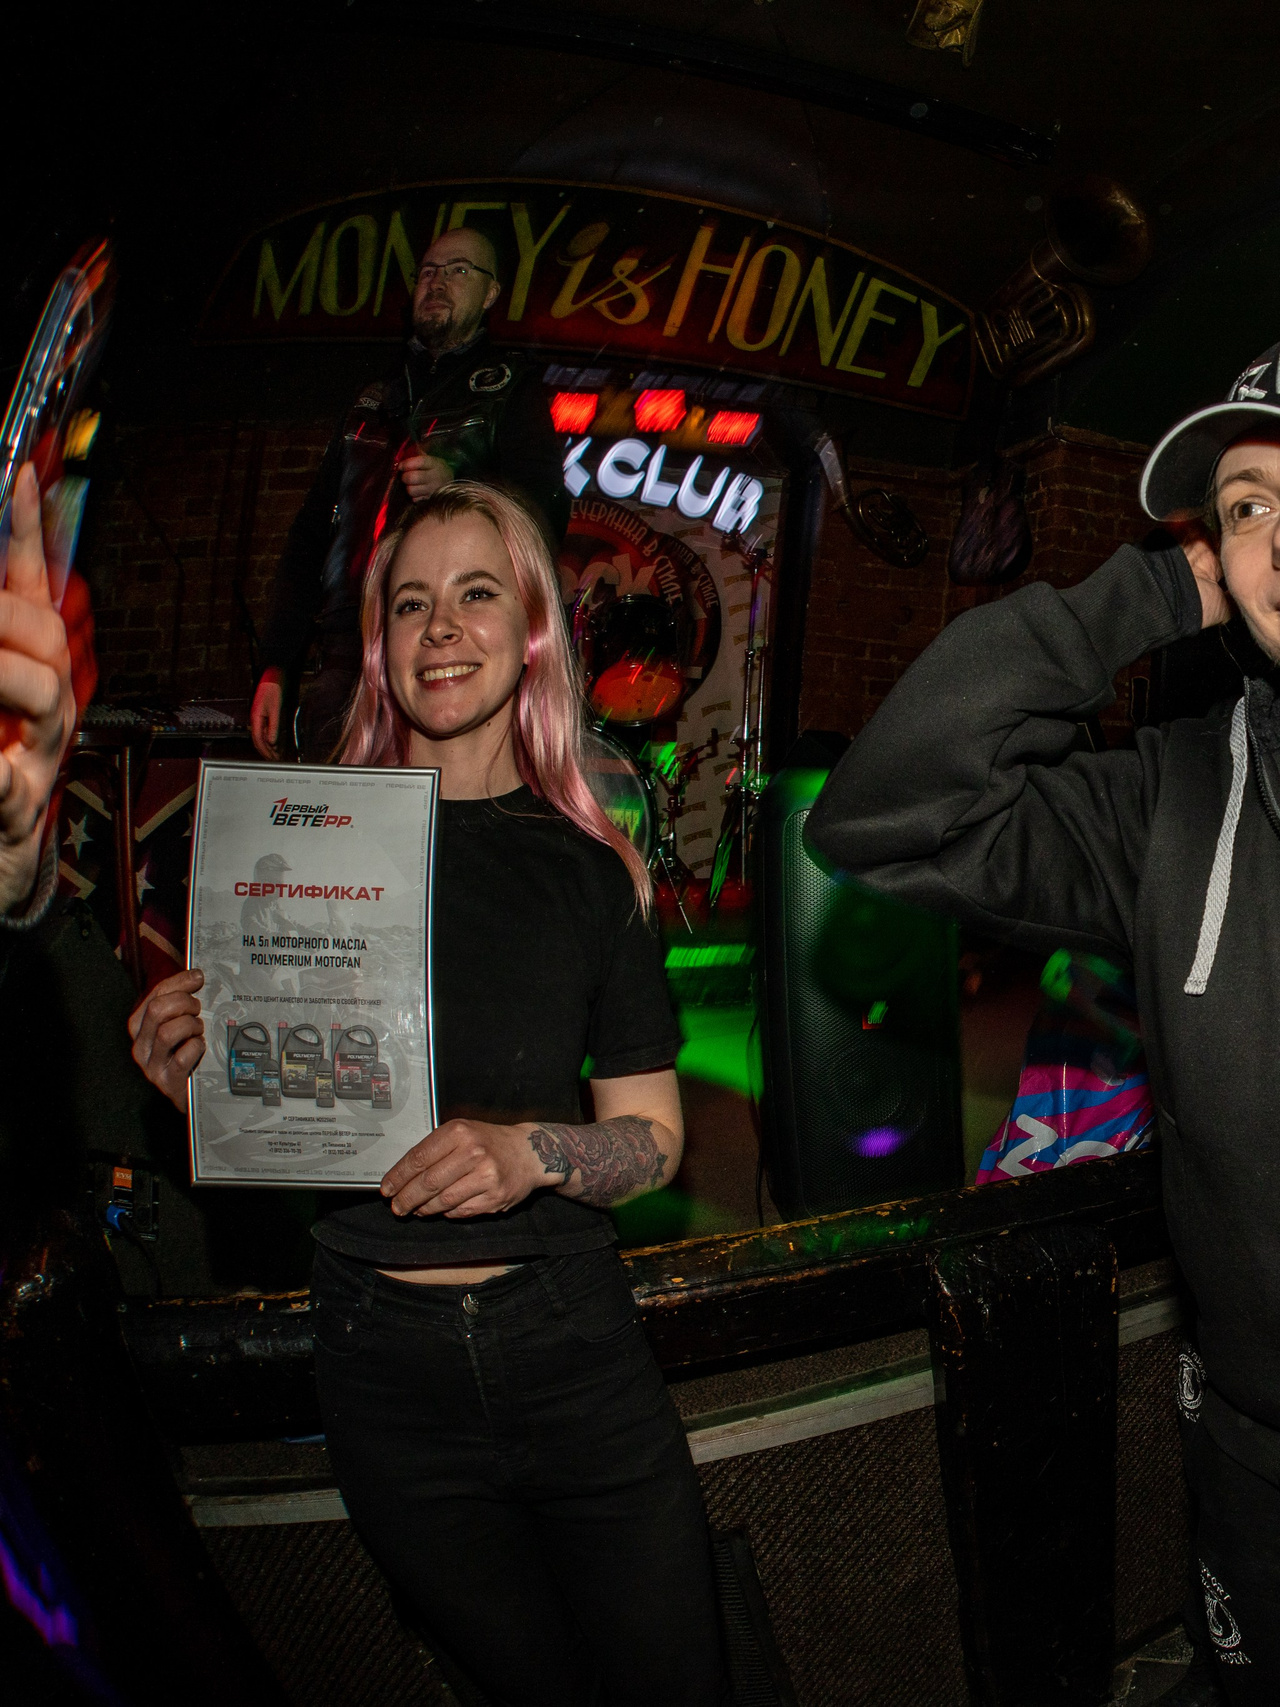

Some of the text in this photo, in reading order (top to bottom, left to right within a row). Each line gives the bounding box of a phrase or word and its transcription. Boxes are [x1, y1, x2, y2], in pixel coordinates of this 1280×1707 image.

[551, 221, 670, 326] is
[662, 216, 964, 388] HONEY
[596, 437, 765, 535] CLUB
[642, 539, 659, 558] В
[653, 554, 684, 606] СТИЛЕ
[272, 814, 352, 828] ВЕТЕРР
[234, 882, 385, 901] СЕРТИФИКАТ
[242, 935, 255, 947] НА
[271, 936, 329, 950] МОТОРНОГО
[332, 938, 368, 951] МАСЛА
[250, 953, 361, 968] POLYMERIUM MOTOFAN
